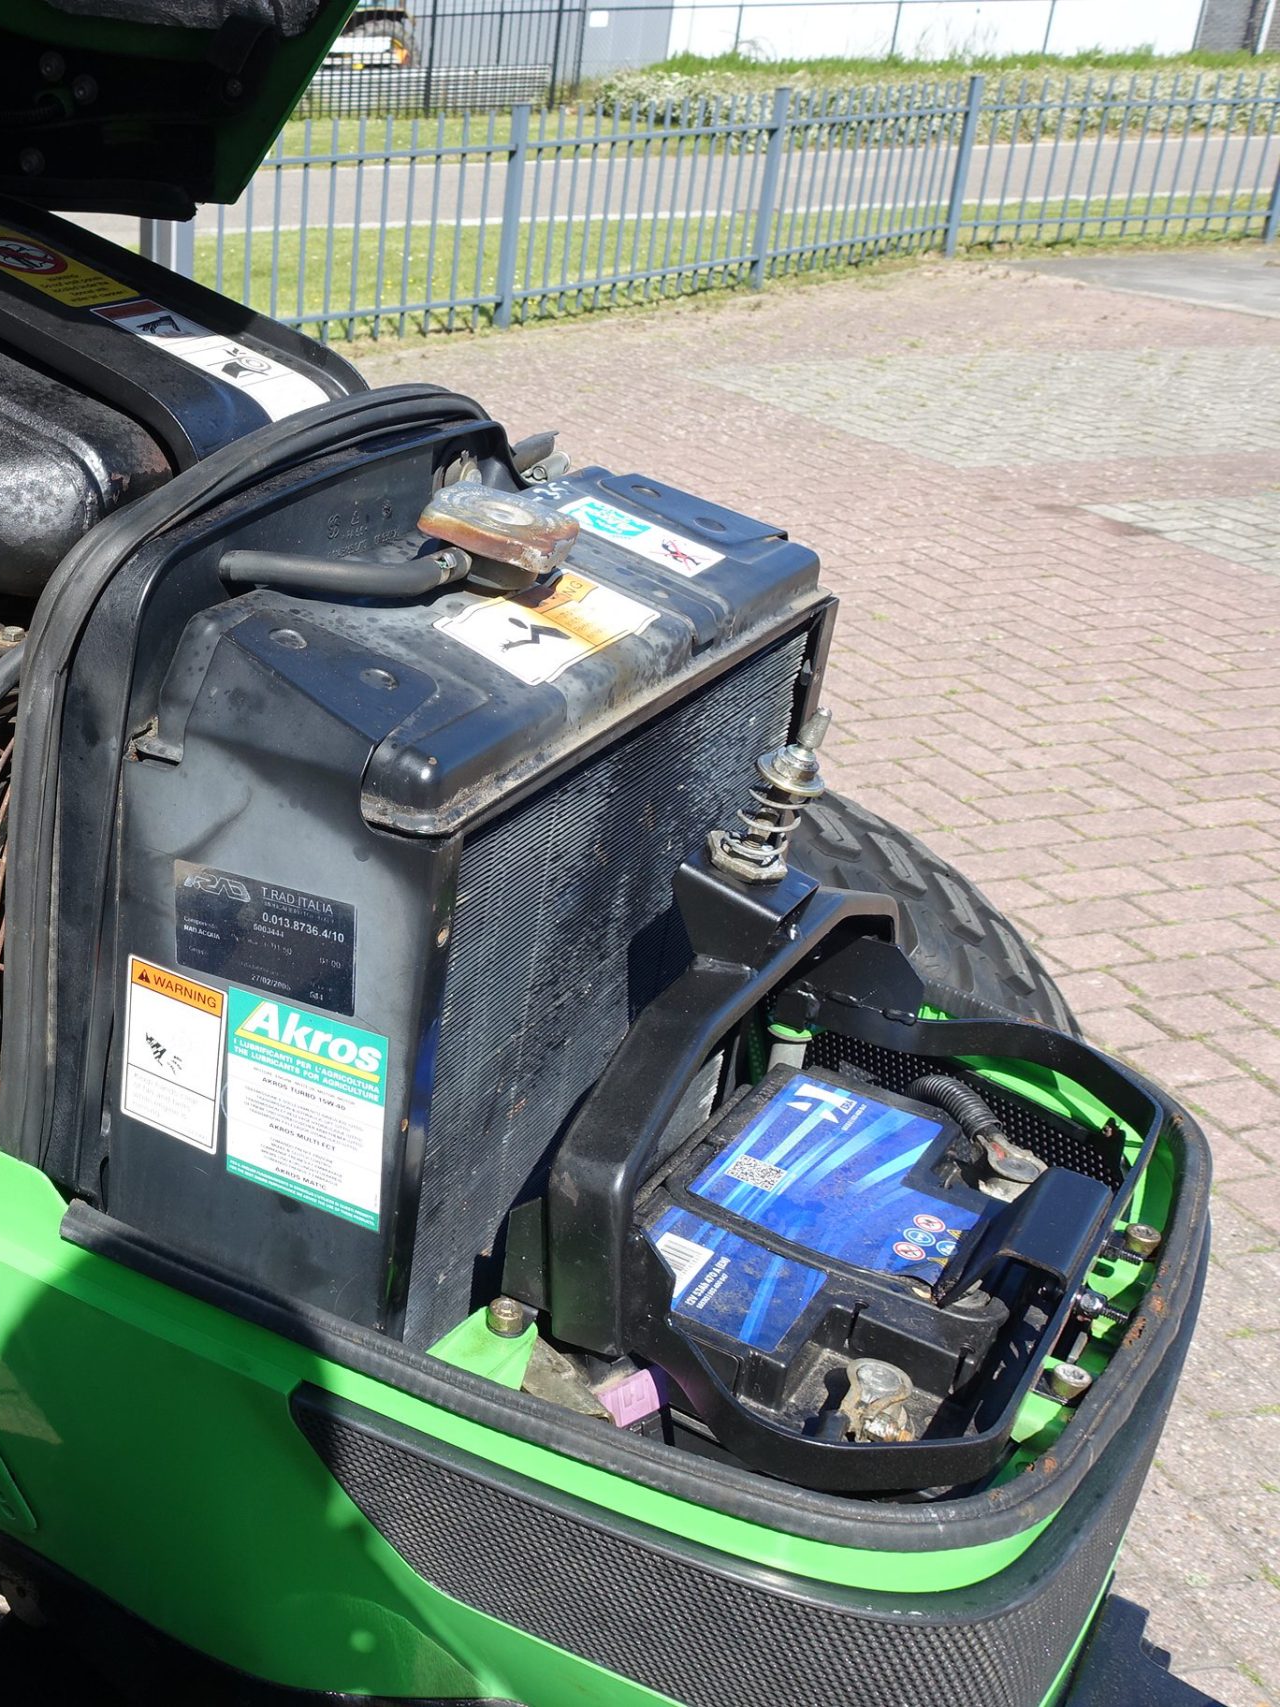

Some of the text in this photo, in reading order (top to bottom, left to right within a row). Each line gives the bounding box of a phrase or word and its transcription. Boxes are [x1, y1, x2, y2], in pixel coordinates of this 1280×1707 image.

[298, 896, 332, 914] ITALIA
[153, 974, 218, 1008] WARNING
[241, 1003, 382, 1073] Akros
[234, 1045, 247, 1056] THE
[251, 1051, 299, 1074] LUBRICANTS
[303, 1069, 318, 1080] FOR
[322, 1076, 378, 1101] AGRICULTURE
[239, 1039, 292, 1064] LUBRIFICANTI
[296, 1059, 310, 1070] PER
[314, 1065, 379, 1094] L'AGRICOLTURA
[261, 1076, 288, 1090] AKROS
[290, 1086, 316, 1100] TURBO
[268, 1121, 294, 1136] AKROS
[275, 1165, 300, 1180] AKROS
[685, 1294, 698, 1306] 12V
[704, 1271, 718, 1284] 470
